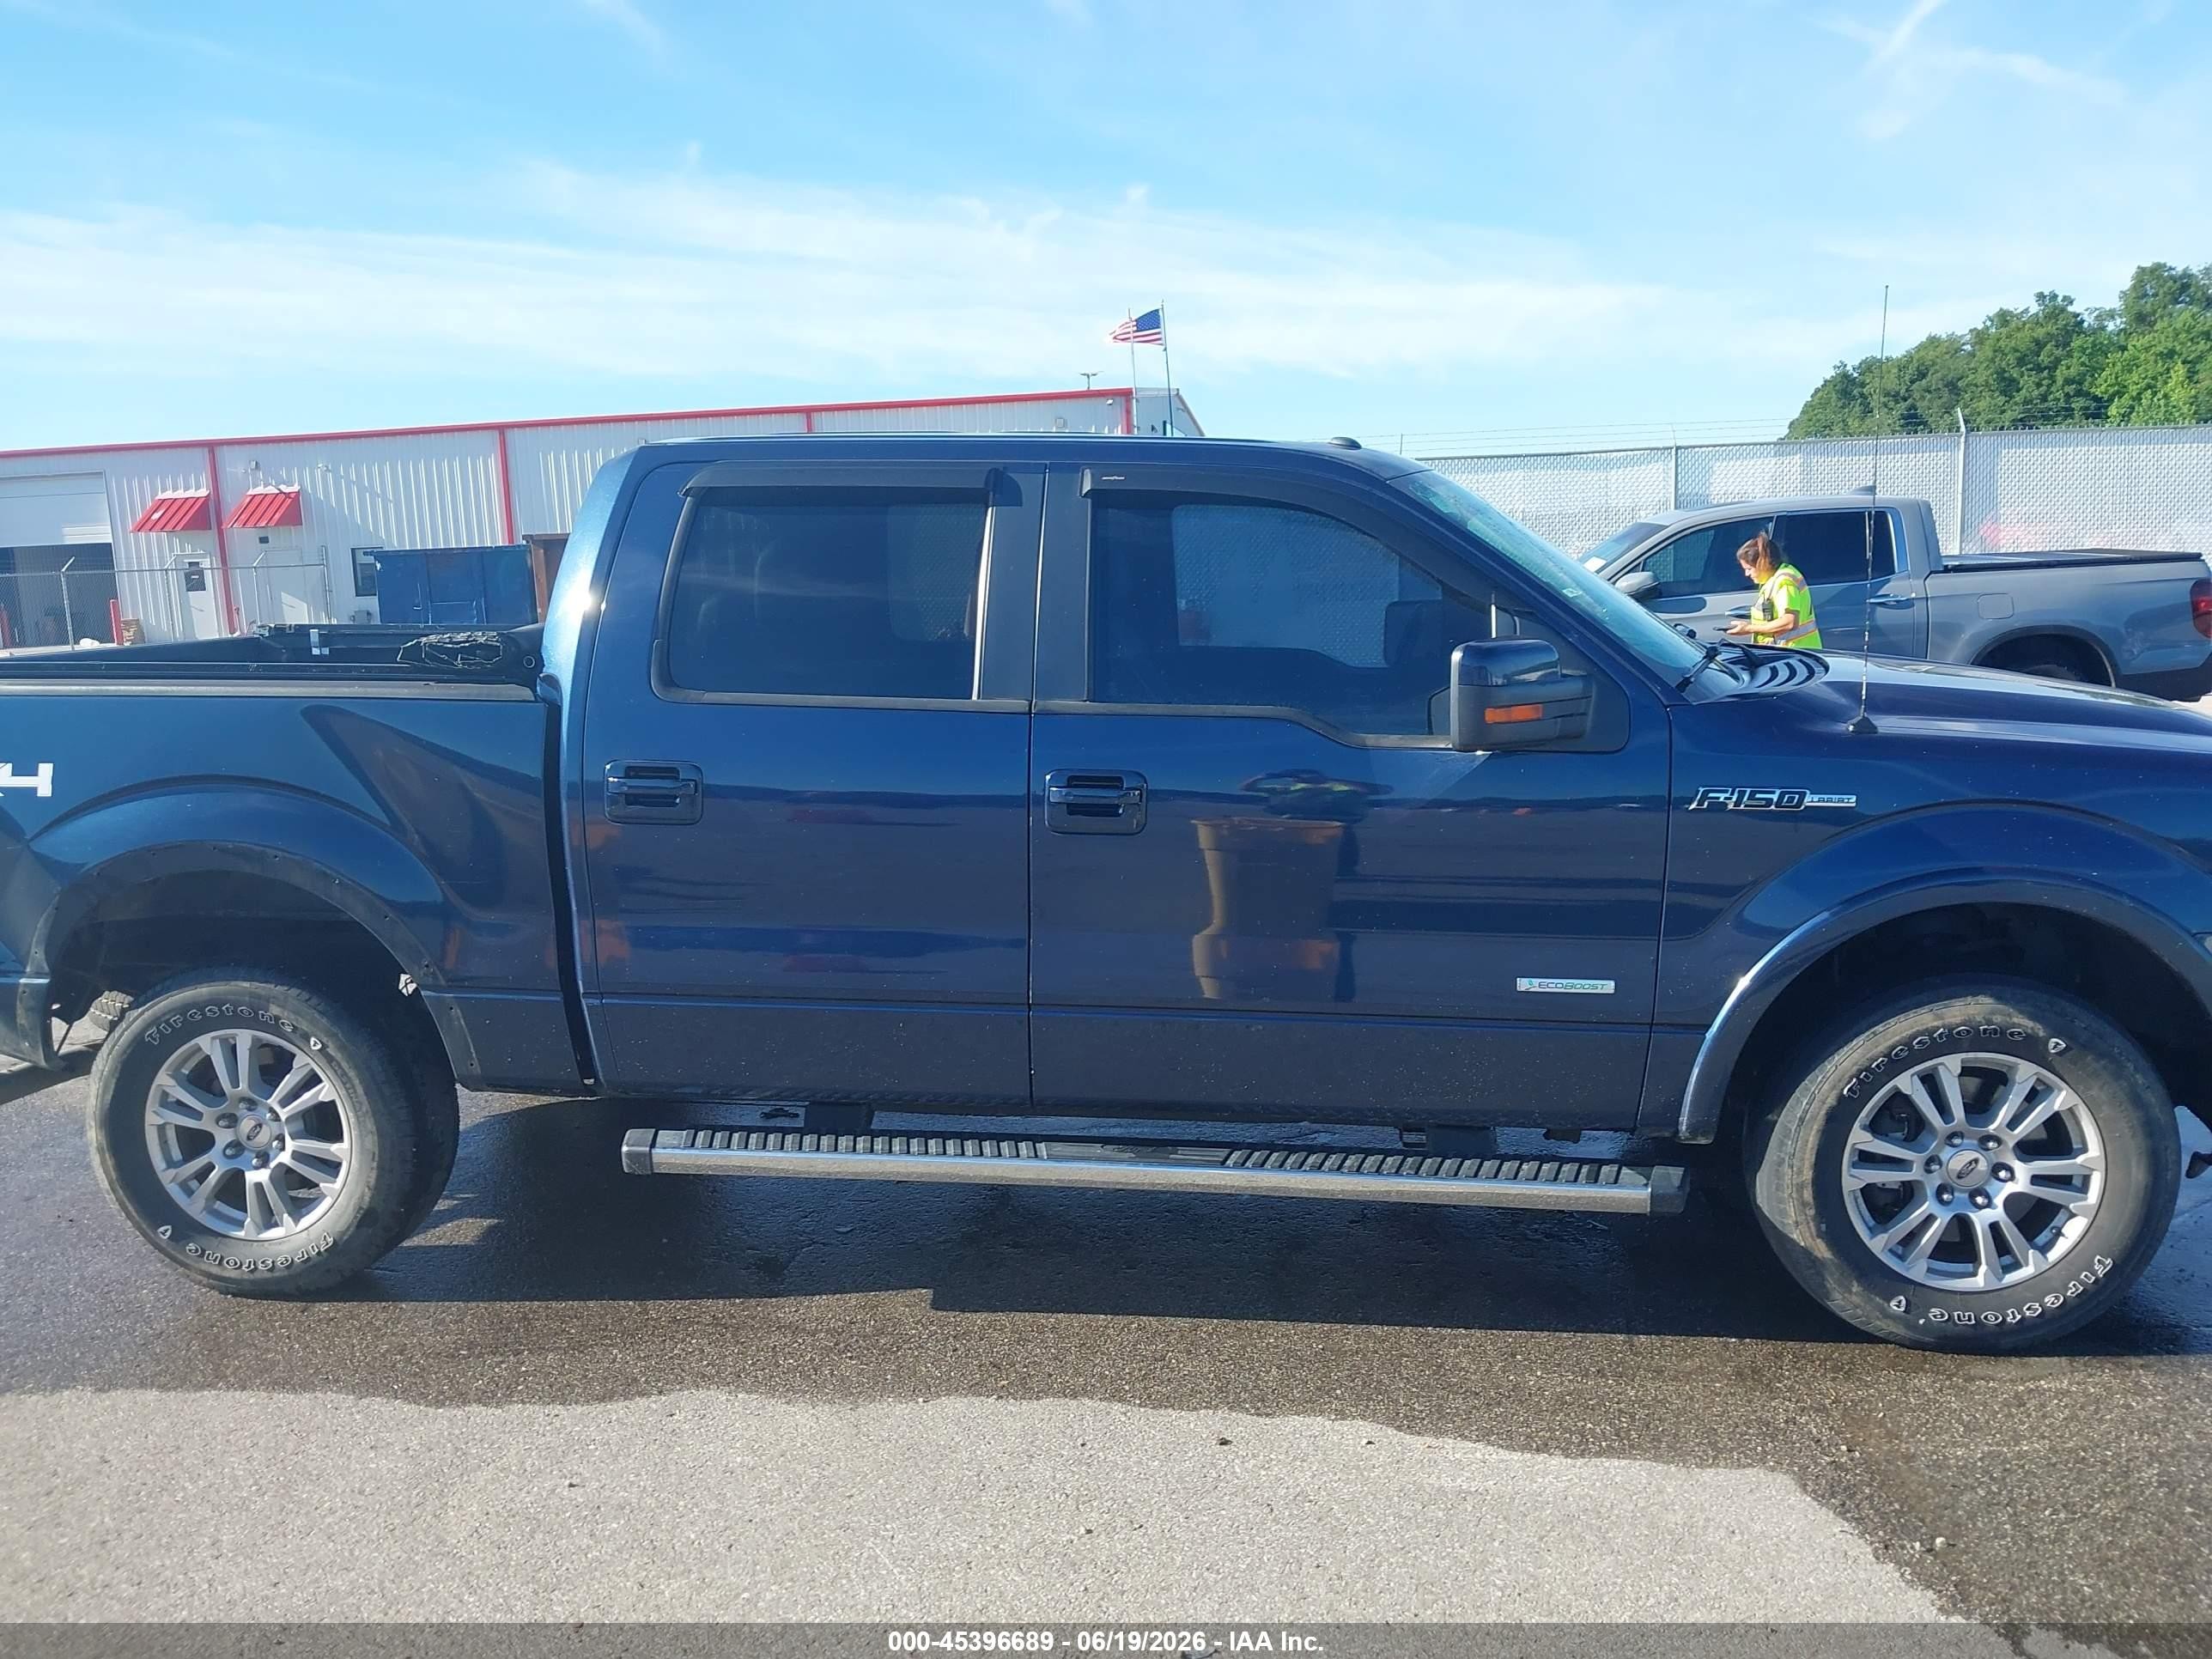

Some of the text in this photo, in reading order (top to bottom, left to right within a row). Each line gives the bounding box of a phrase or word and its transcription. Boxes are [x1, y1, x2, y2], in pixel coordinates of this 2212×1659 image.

[1688, 787, 1809, 811] F-150
[1538, 981, 1608, 991] ECOBOOST
[145, 1003, 294, 1044] Firestone
[1844, 1025, 2027, 1098] Firestone
[185, 1232, 333, 1271] Firestone
[1929, 1255, 2113, 1324] Firestone
